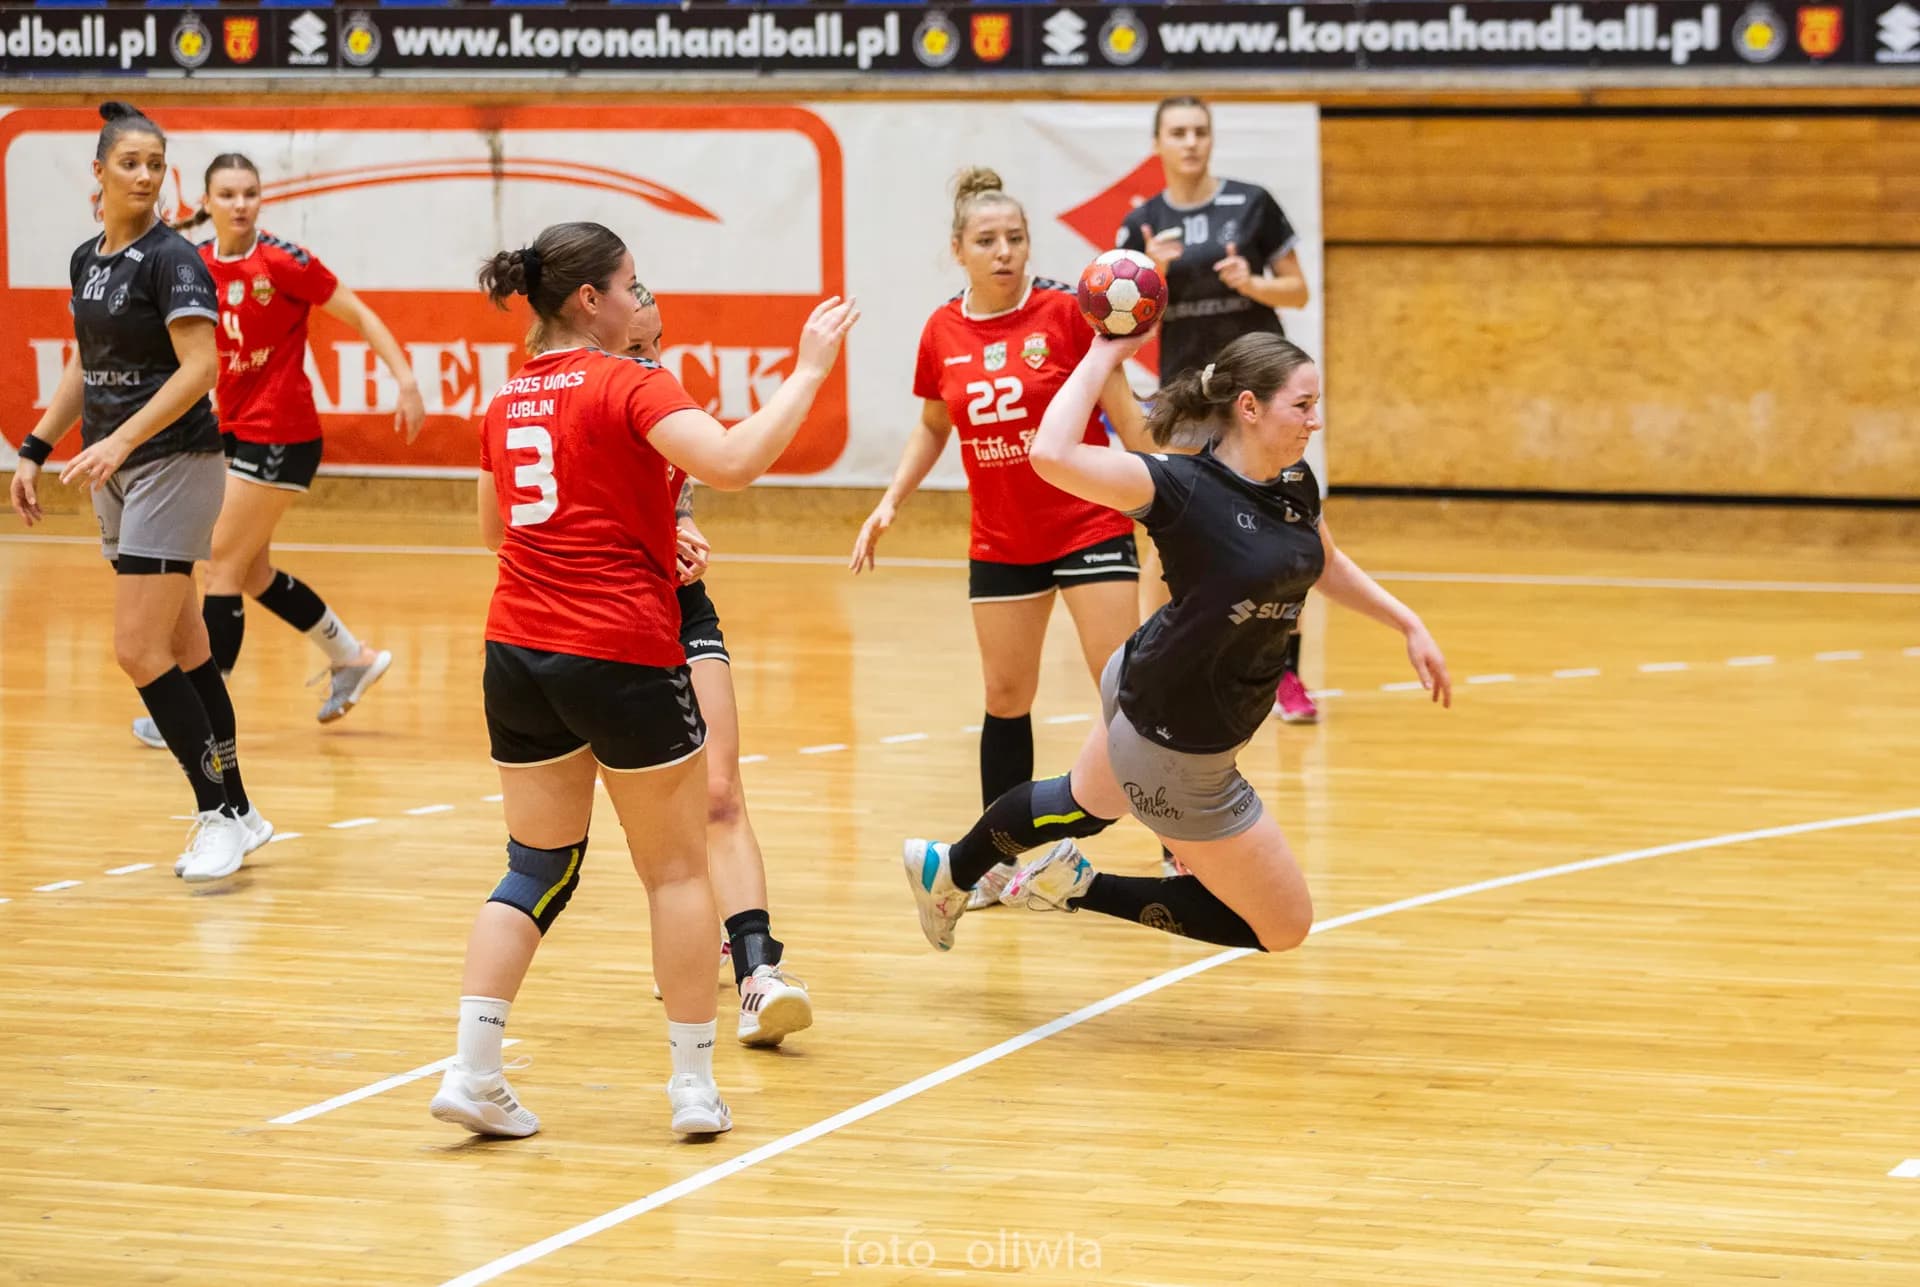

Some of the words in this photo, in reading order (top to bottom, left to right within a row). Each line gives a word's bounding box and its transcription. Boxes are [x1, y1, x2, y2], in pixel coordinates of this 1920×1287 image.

[0, 15, 157, 69] dball.pl
[393, 13, 900, 70] www.koronahandball.pl
[1158, 5, 1721, 65] www.koronahandball.pl
[1182, 213, 1209, 245] 10
[222, 311, 244, 347] 4
[543, 370, 587, 391] UMCS
[506, 399, 555, 419] LUBLIN
[966, 375, 1028, 426] 22
[506, 425, 558, 527] 3
[1237, 511, 1258, 530] CK
[1255, 602, 1304, 620] SUZ
[1123, 782, 1169, 812] Pink
